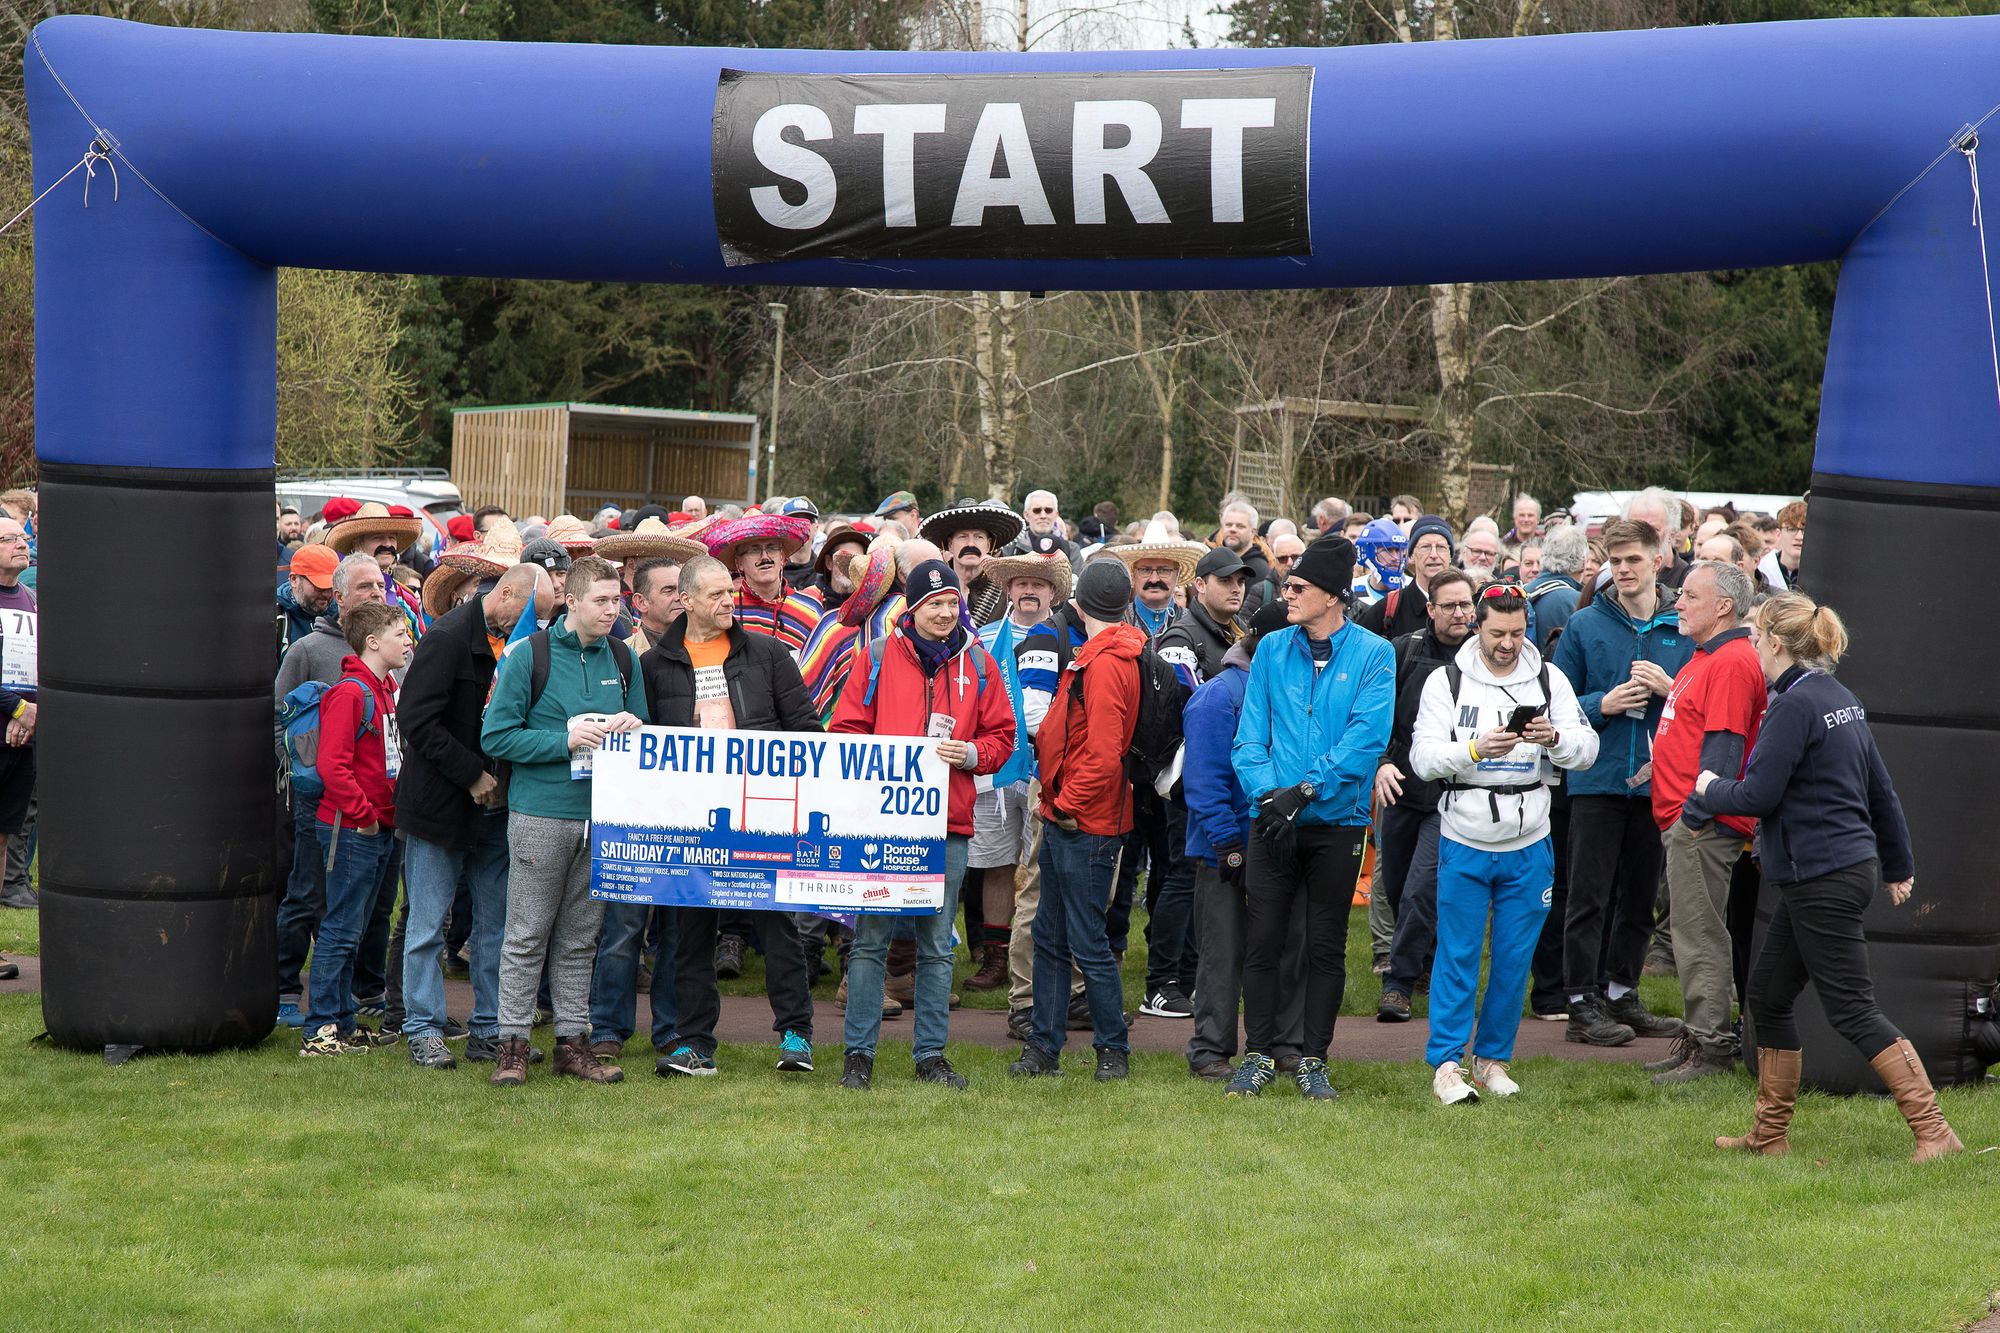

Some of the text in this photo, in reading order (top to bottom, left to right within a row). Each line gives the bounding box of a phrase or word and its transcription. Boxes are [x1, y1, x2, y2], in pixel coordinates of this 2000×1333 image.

[749, 98, 1276, 229] START
[1824, 706, 1853, 729] EVENT
[601, 731, 925, 783] THE BATH RUGBY WALK
[880, 785, 941, 816] 2020
[628, 832, 700, 845] FANCY A FREE PIE AND PINT?
[600, 840, 729, 866] SATURDAY 7TH MARCH
[796, 850, 820, 858] BATH
[883, 843, 929, 857] Dorothy
[757, 853, 767, 861] aged
[883, 854, 920, 865] House
[603, 863, 617, 871] STARTS
[635, 866, 655, 874] DOROTHY
[671, 868, 690, 876] WINSLEY
[712, 870, 723, 878] TWO
[731, 871, 749, 879] NATIONS
[749, 872, 765, 880] GAMES:
[616, 874, 639, 883] SPONSORED
[713, 880, 728, 888] France
[731, 881, 751, 889] Scotland
[602, 882, 615, 890] FINISH
[800, 882, 854, 895] THRINGS
[863, 886, 890, 899] chunk
[621, 894, 653, 903] REFRESHMENTS
[712, 890, 730, 898] England
